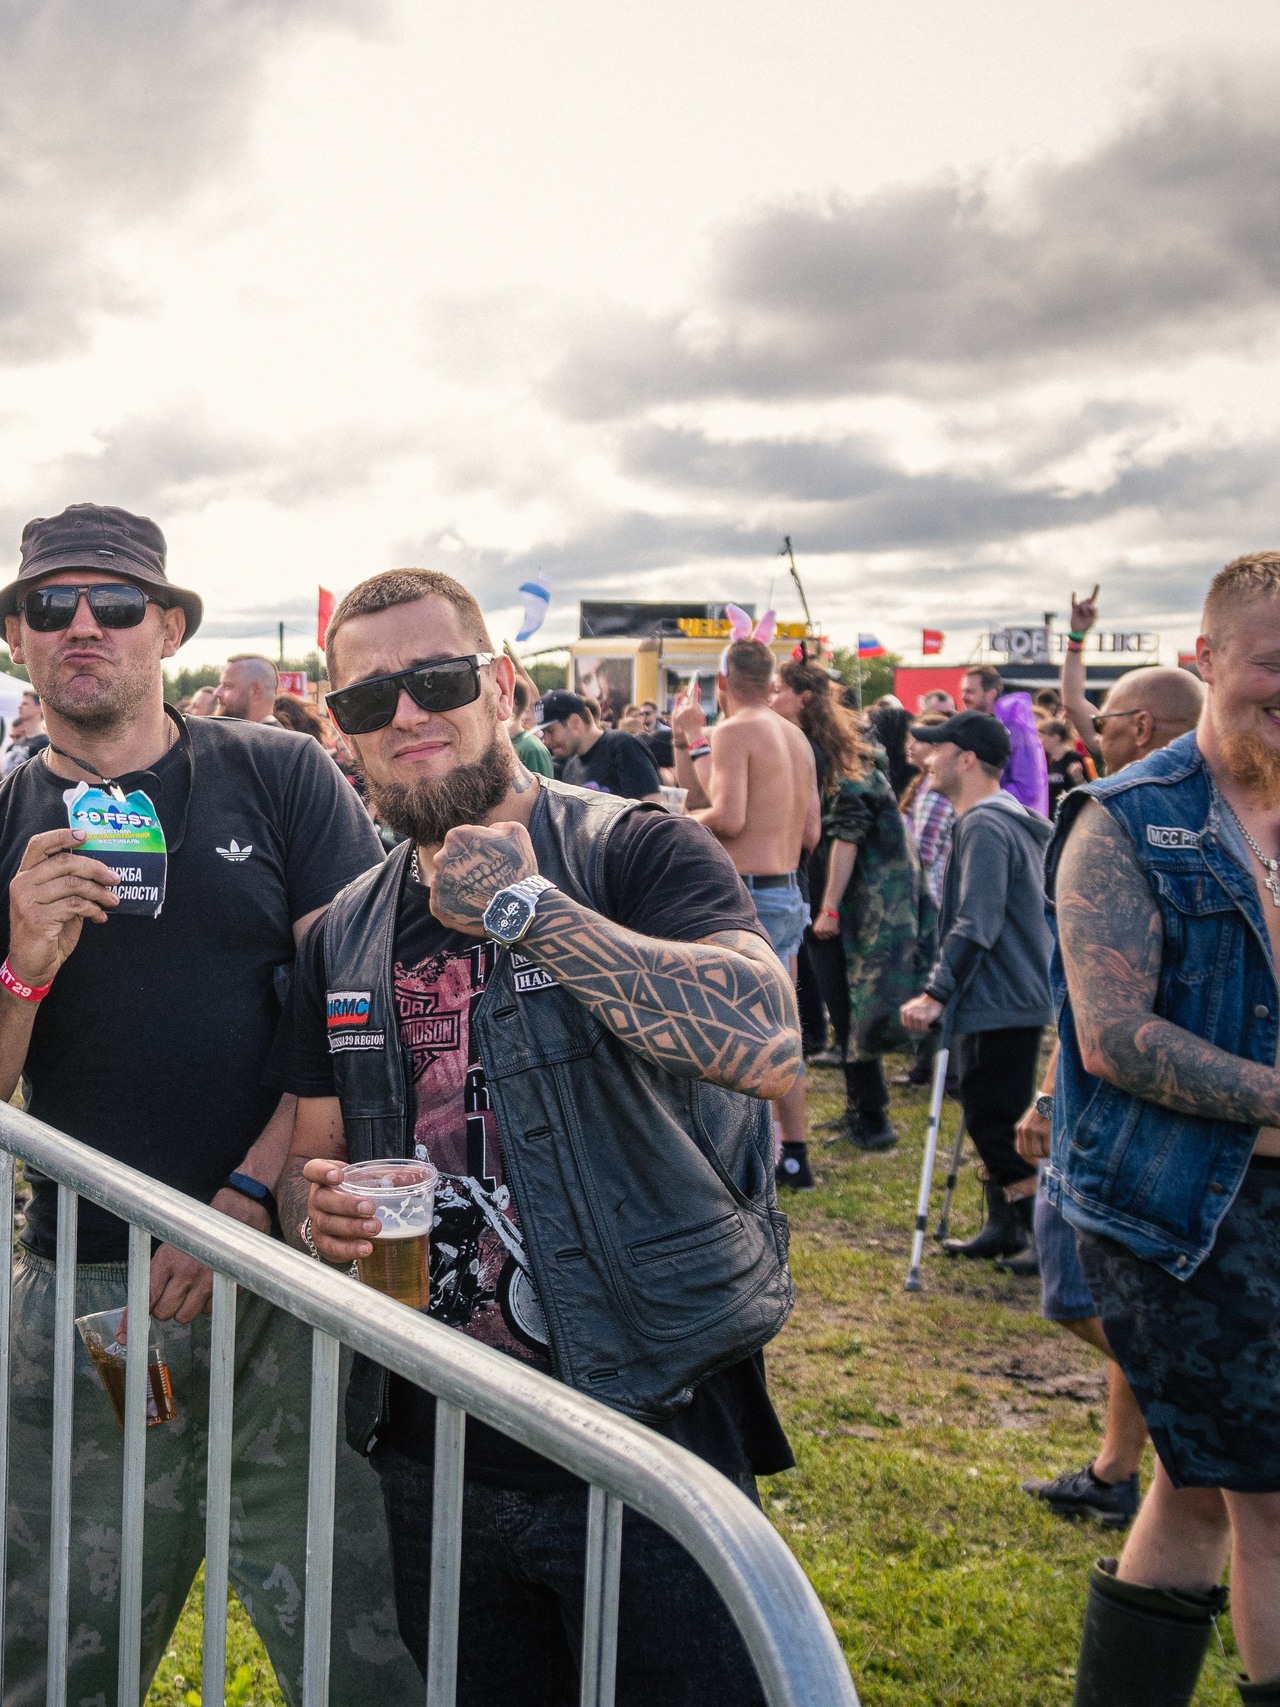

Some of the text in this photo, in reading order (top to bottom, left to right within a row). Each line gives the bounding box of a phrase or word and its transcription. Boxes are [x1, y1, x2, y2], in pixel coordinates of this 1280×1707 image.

[76, 811, 152, 827] 29 FEST
[1151, 829, 1178, 846] MCC
[11, 981, 33, 998] 29
[354, 1034, 385, 1046] REGION
